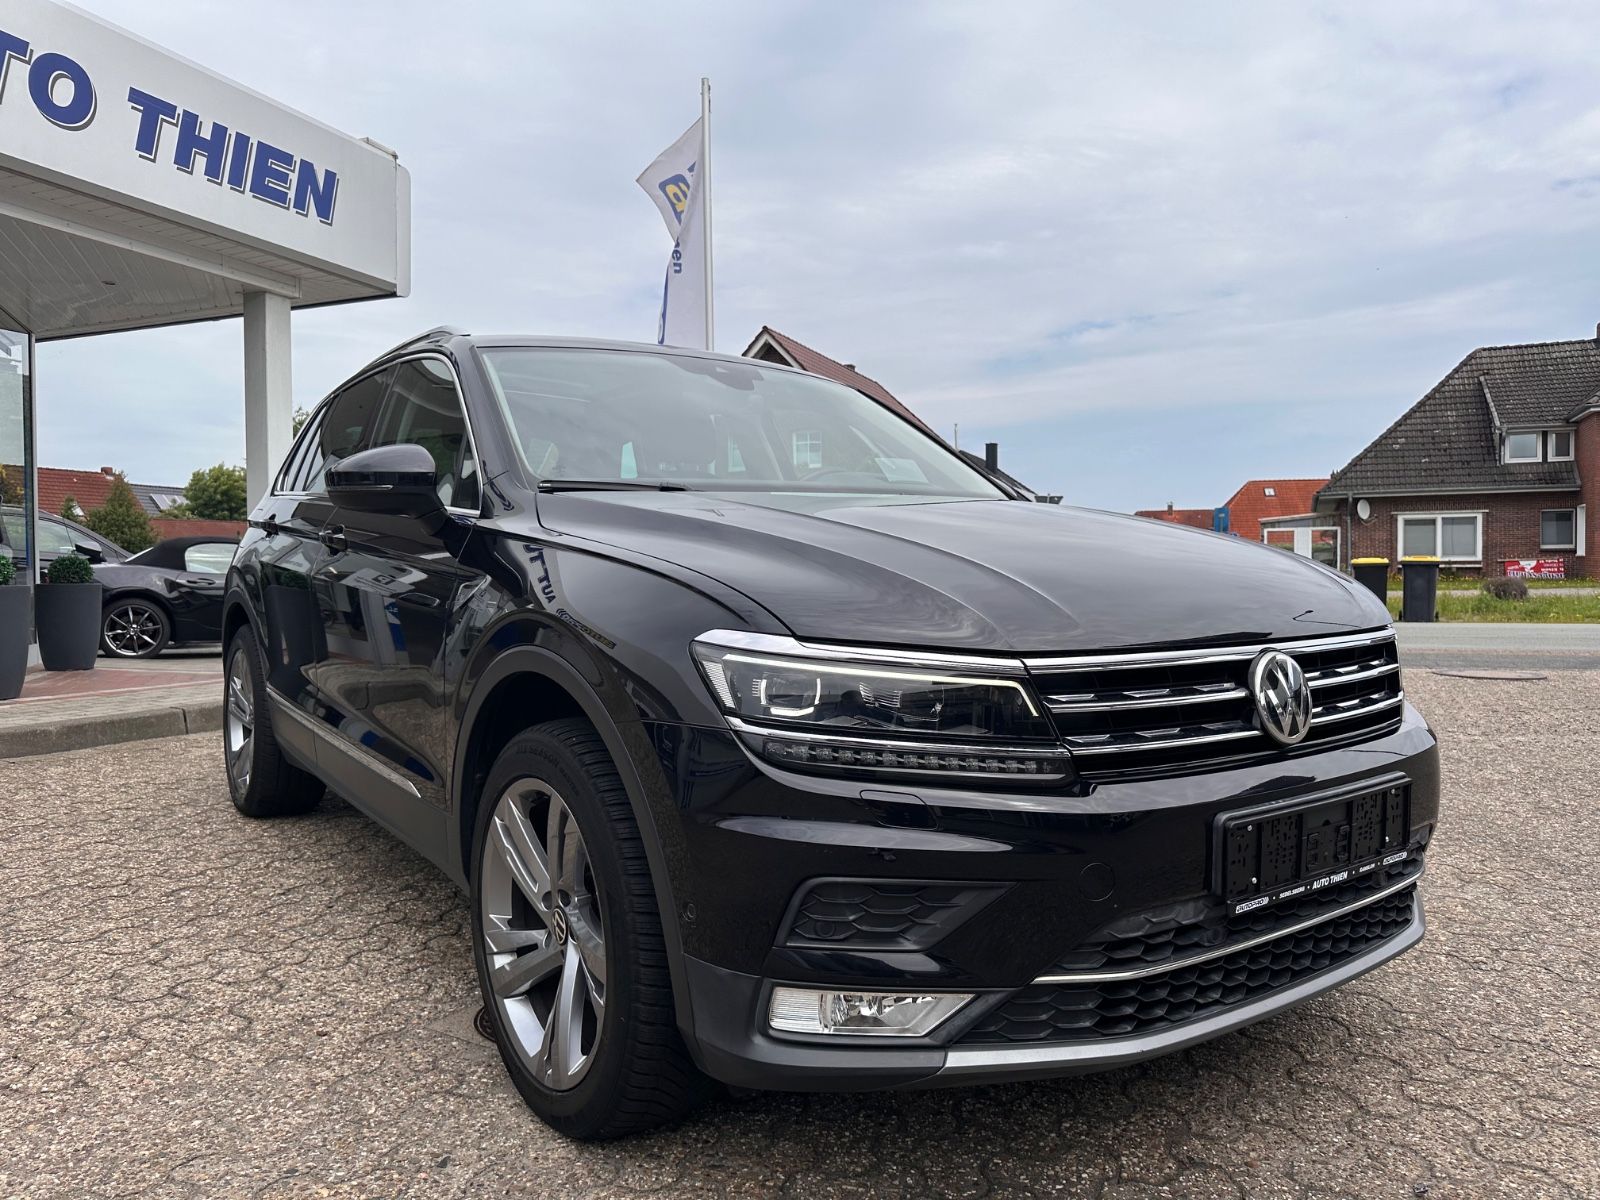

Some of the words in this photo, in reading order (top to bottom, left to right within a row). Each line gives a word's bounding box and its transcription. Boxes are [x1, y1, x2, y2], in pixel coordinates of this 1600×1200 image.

[128, 86, 339, 226] THIEN
[1312, 877, 1330, 890] AUTO
[1330, 871, 1348, 886] THIEN
